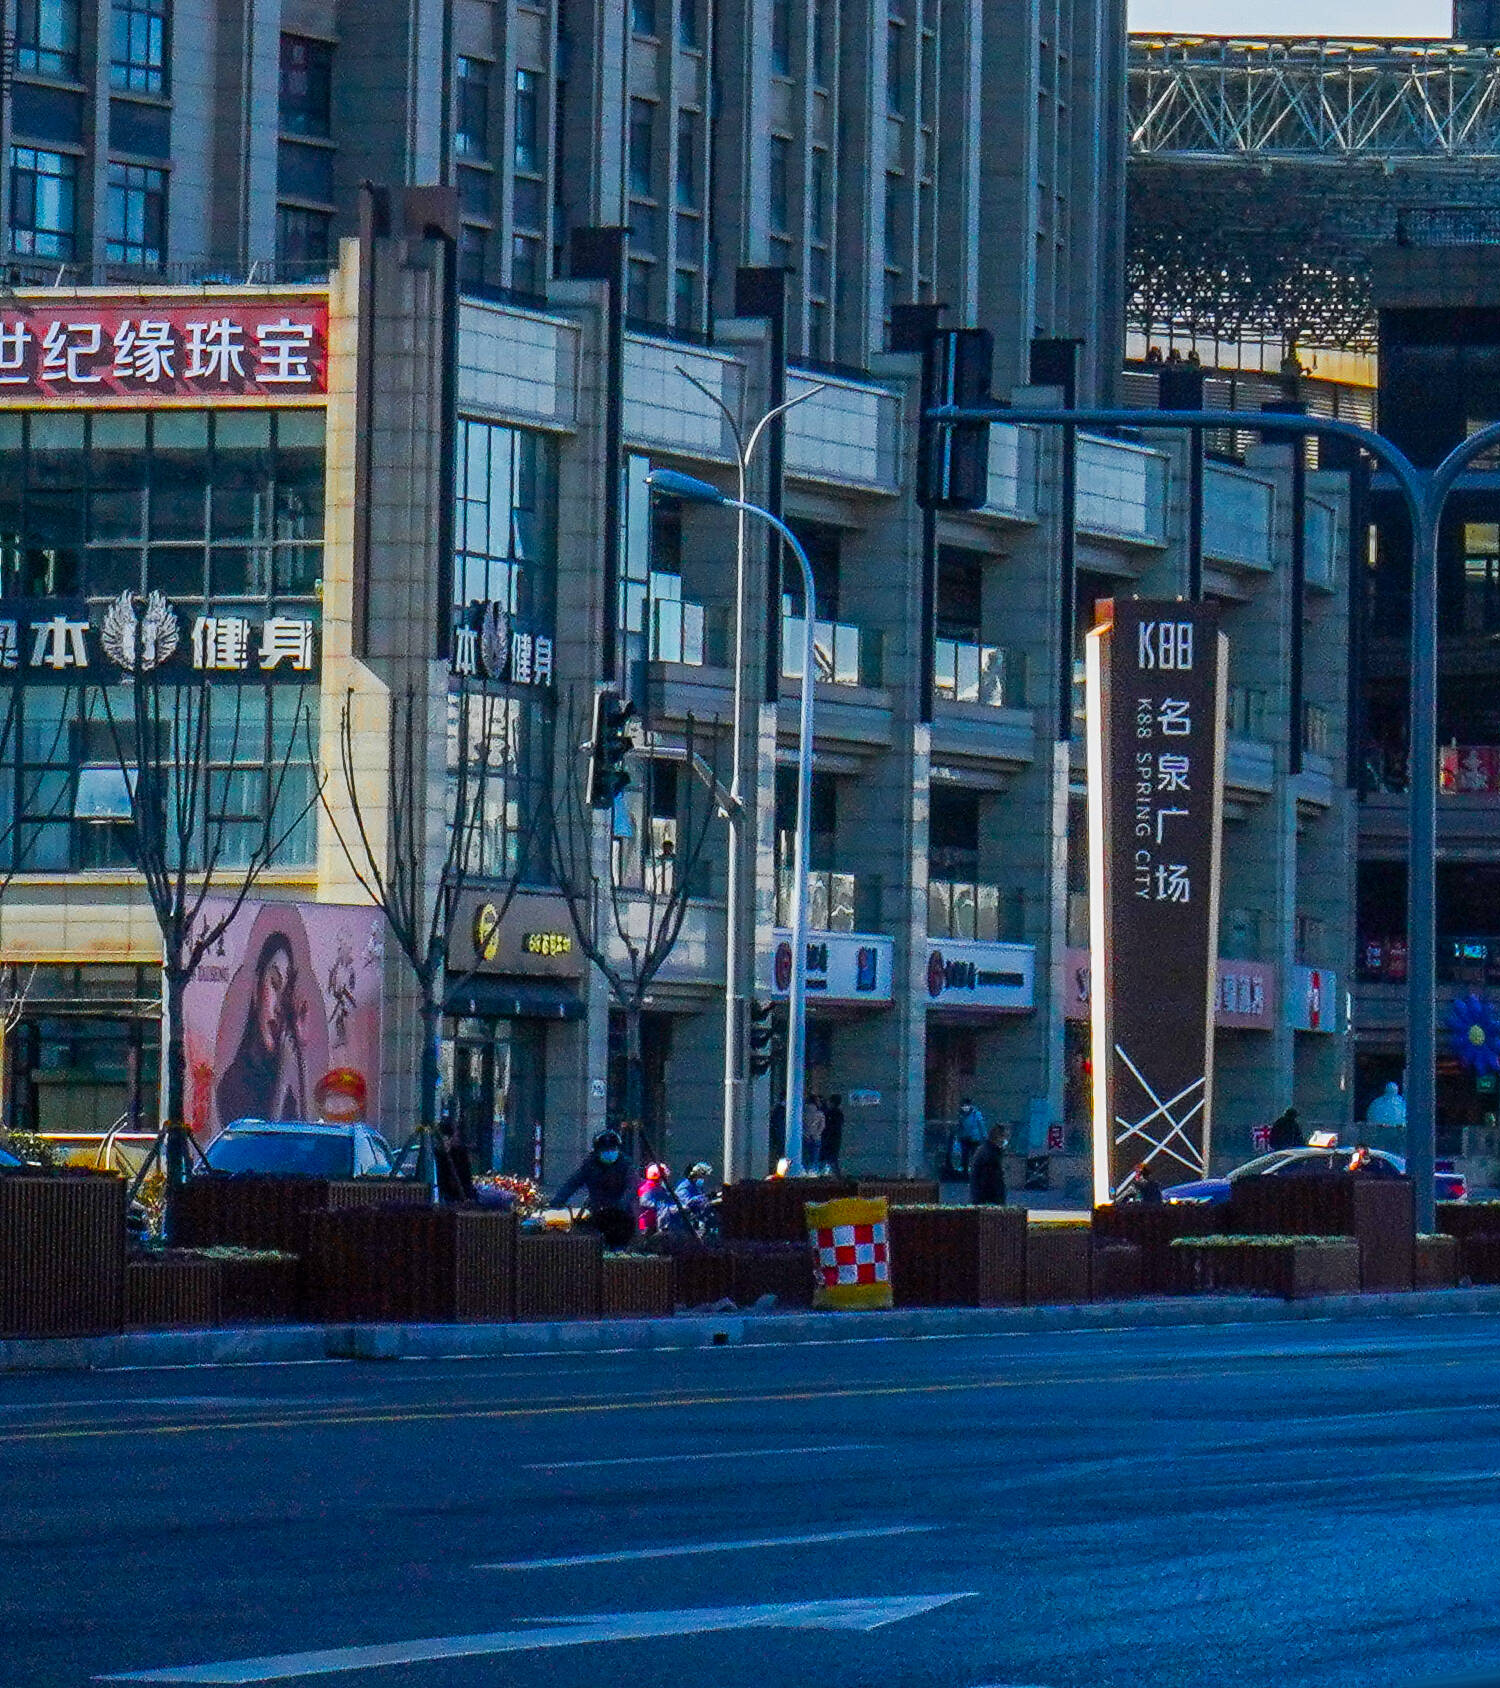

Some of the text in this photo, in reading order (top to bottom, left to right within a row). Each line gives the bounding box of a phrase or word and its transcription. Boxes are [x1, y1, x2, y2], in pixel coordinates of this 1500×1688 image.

[191, 615, 313, 670] 健身
[1138, 621, 1193, 670] K88
[1134, 698, 1153, 901] K88 SPRING CITY
[1155, 697, 1192, 904] 名泉广场
